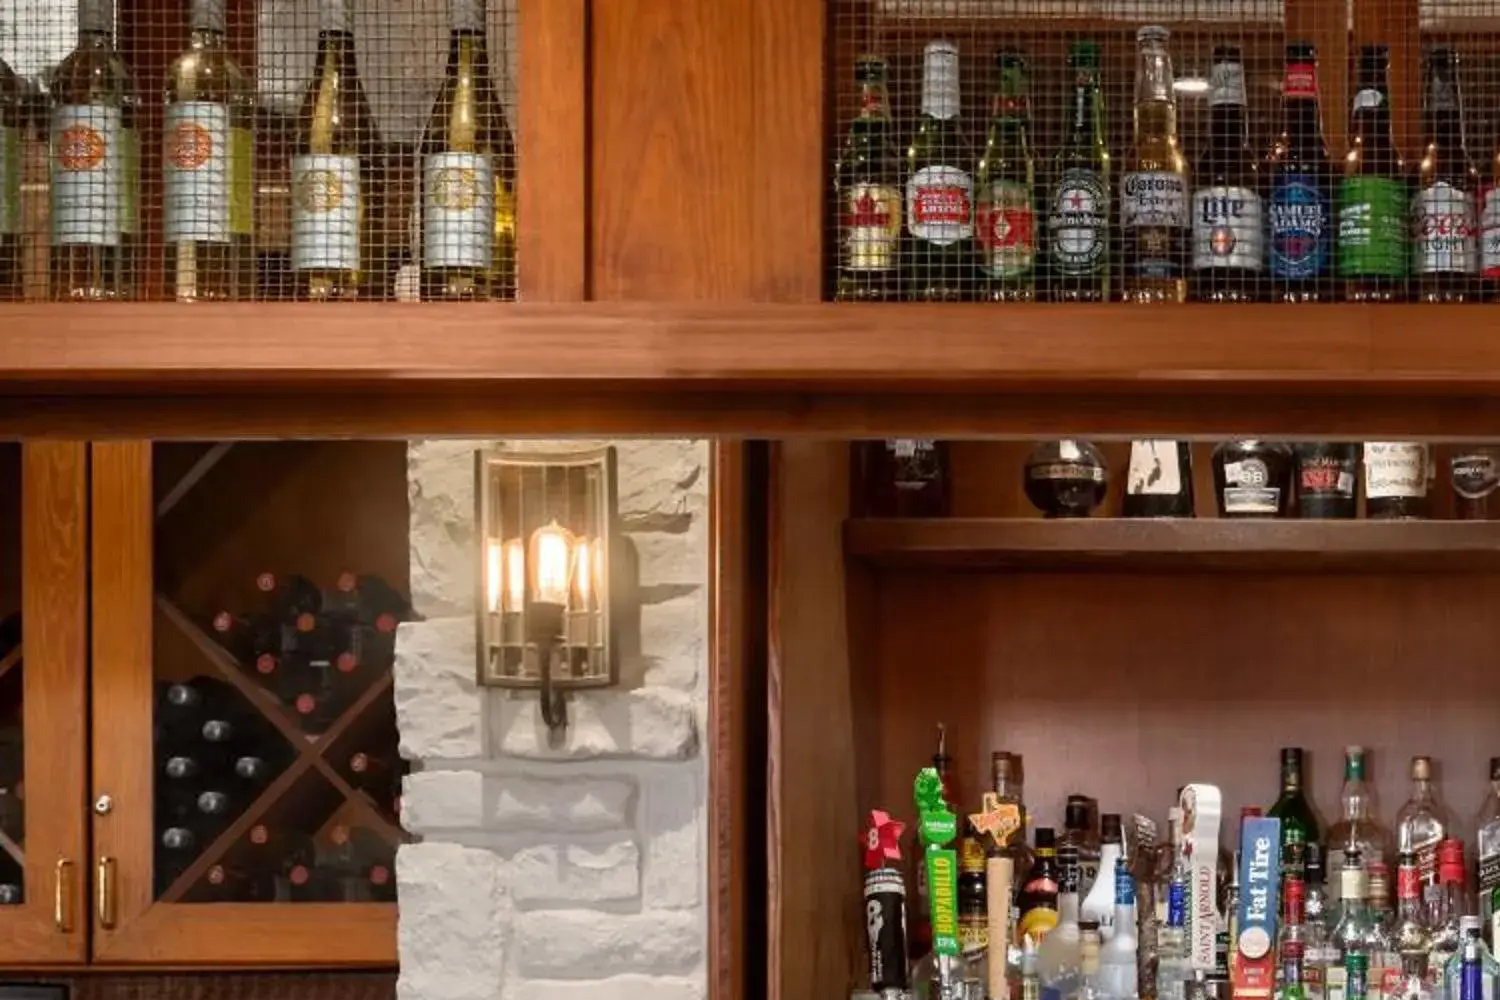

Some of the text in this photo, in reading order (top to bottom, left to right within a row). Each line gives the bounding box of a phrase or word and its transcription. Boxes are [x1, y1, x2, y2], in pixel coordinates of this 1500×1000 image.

[1199, 866, 1214, 965] SAINT ARNOLD
[1246, 837, 1271, 921] Fat Tire
